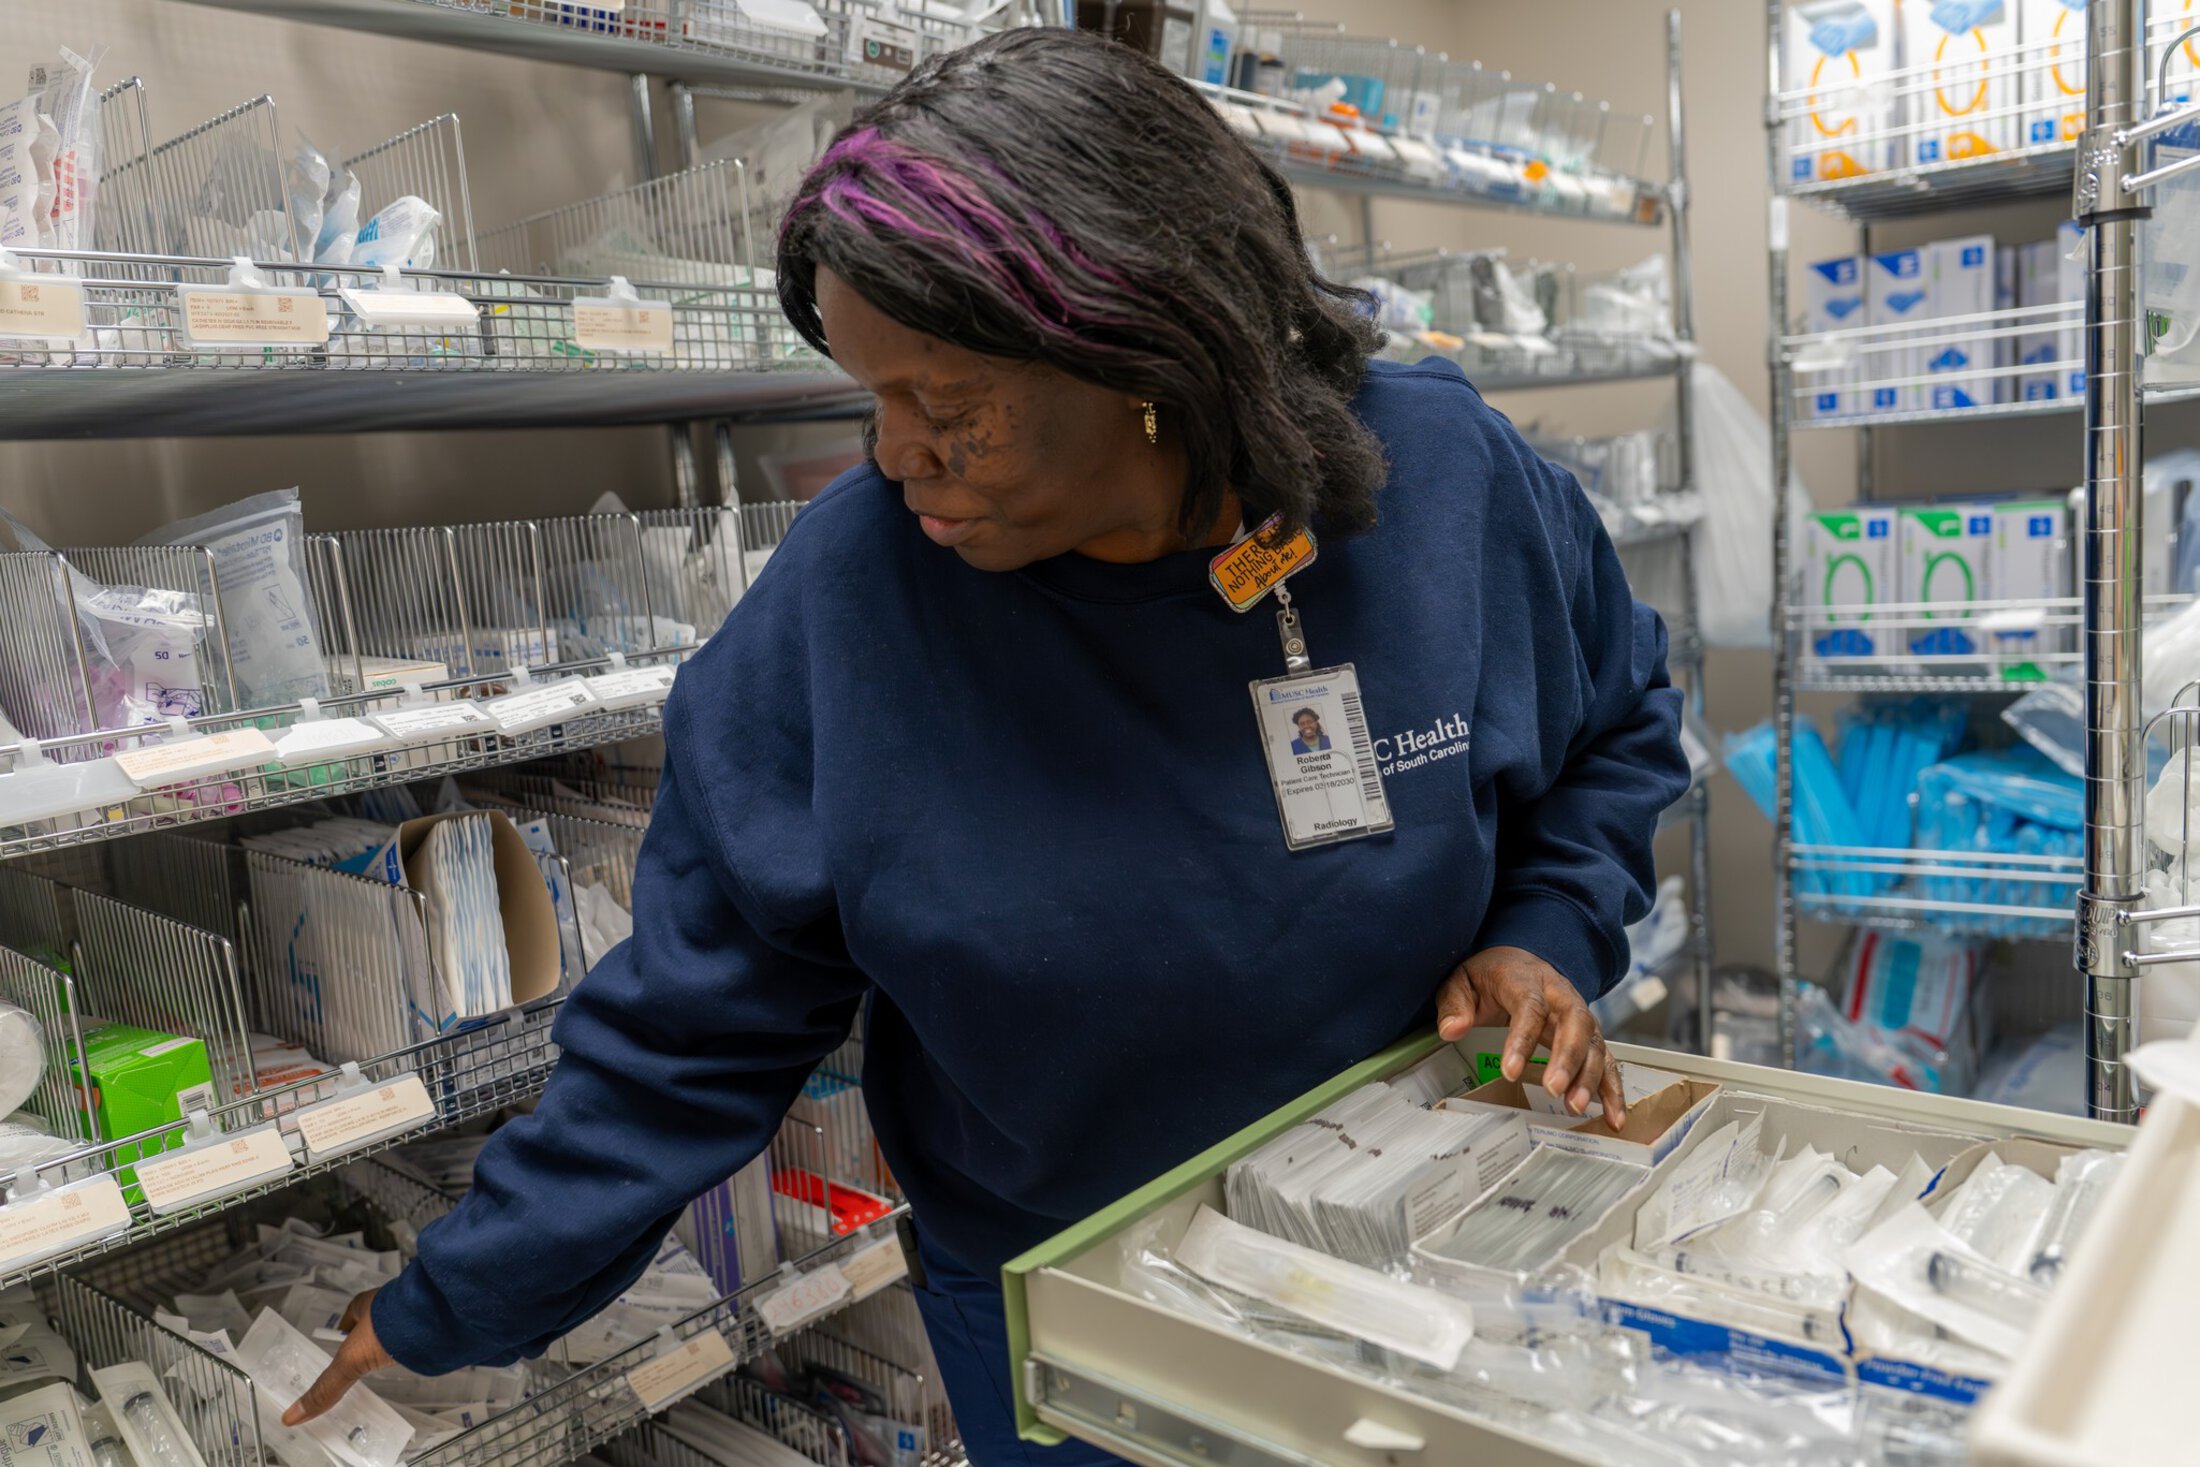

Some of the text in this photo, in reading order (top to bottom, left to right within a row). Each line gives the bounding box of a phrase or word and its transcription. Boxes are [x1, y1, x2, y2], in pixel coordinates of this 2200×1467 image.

[1228, 550, 1273, 593] NOTHING
[1394, 712, 1470, 756] Health
[1296, 753, 1332, 765] Roberta
[1382, 741, 1470, 776] of South Carolin
[1300, 763, 1332, 774] Gibson
[1287, 784, 1314, 796] Expires
[1314, 817, 1358, 831] Radiology
